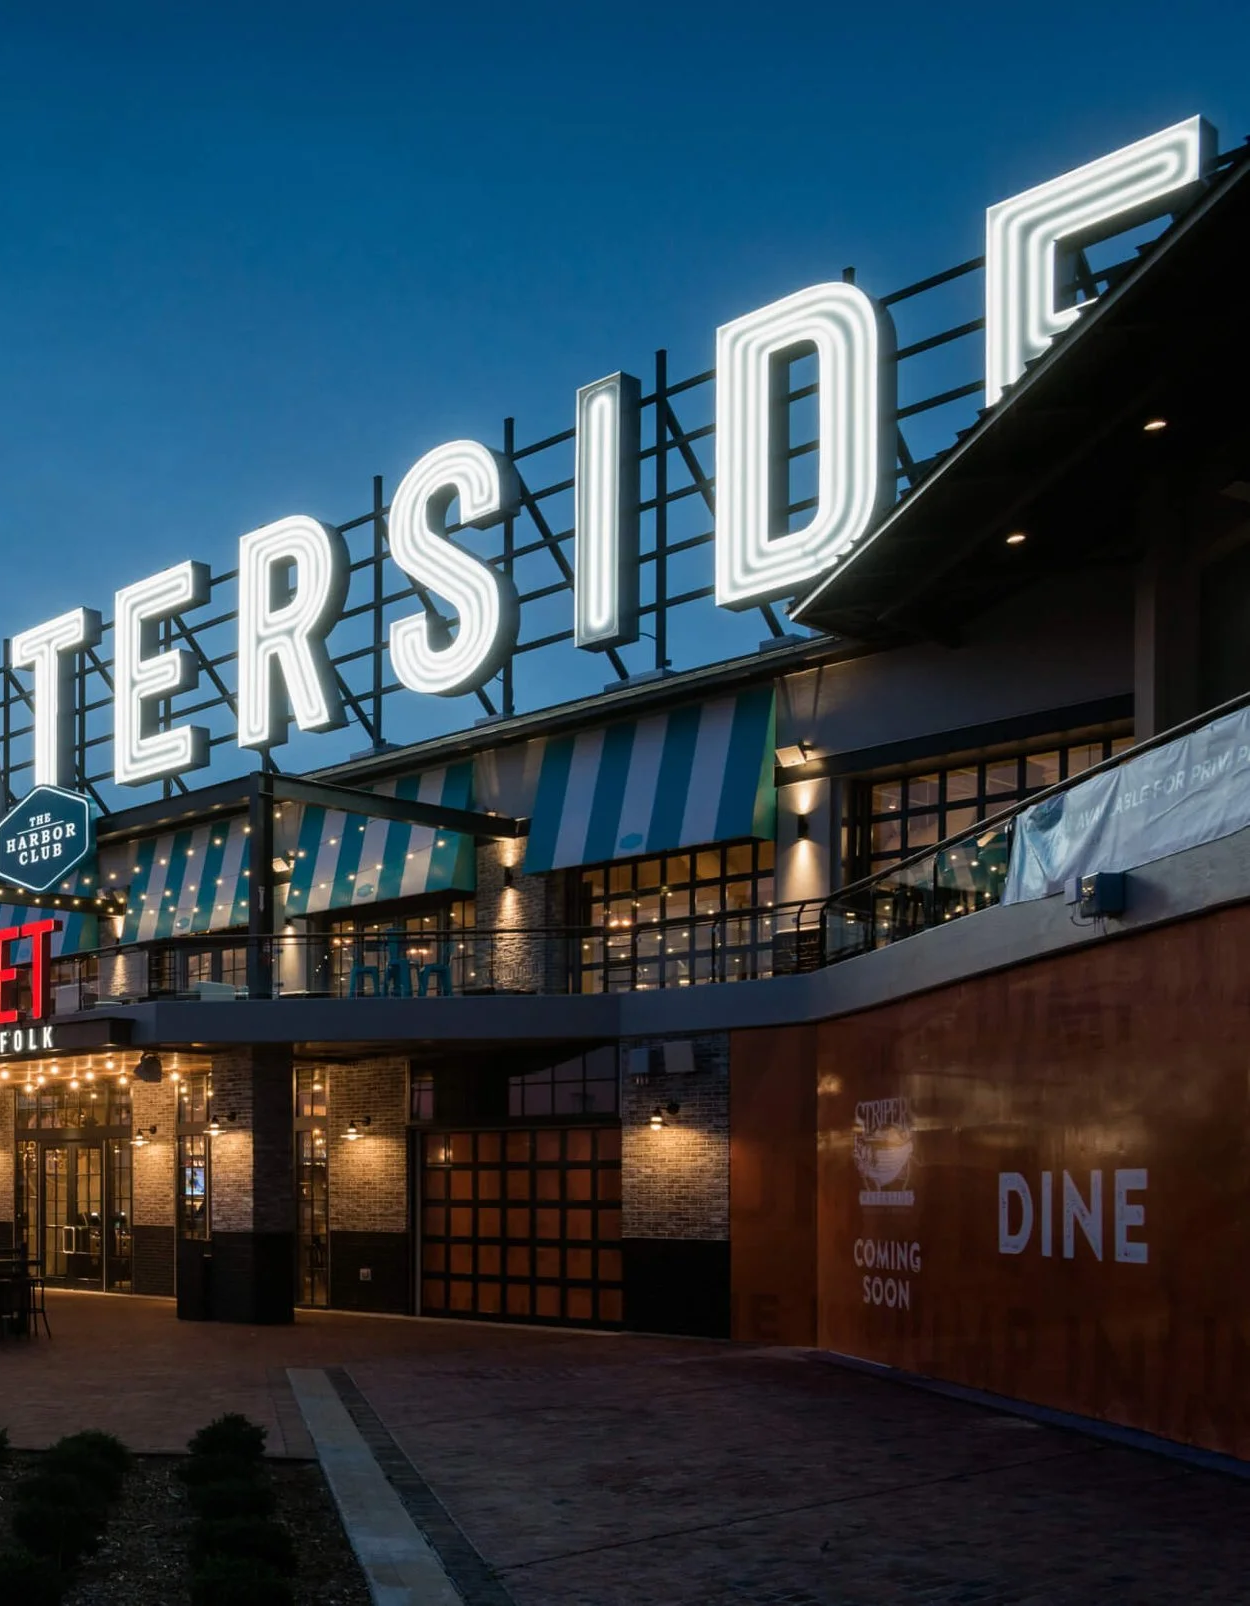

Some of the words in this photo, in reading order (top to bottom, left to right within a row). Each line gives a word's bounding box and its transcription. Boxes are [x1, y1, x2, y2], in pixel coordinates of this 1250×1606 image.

[1153, 770, 1186, 799] FOR
[28, 812, 52, 828] THE
[6, 822, 77, 854] HARBOR
[19, 844, 63, 866] CLUB
[998, 1168, 1149, 1264] DINE
[853, 1238, 922, 1274] COMING
[862, 1275, 911, 1311] SOON
